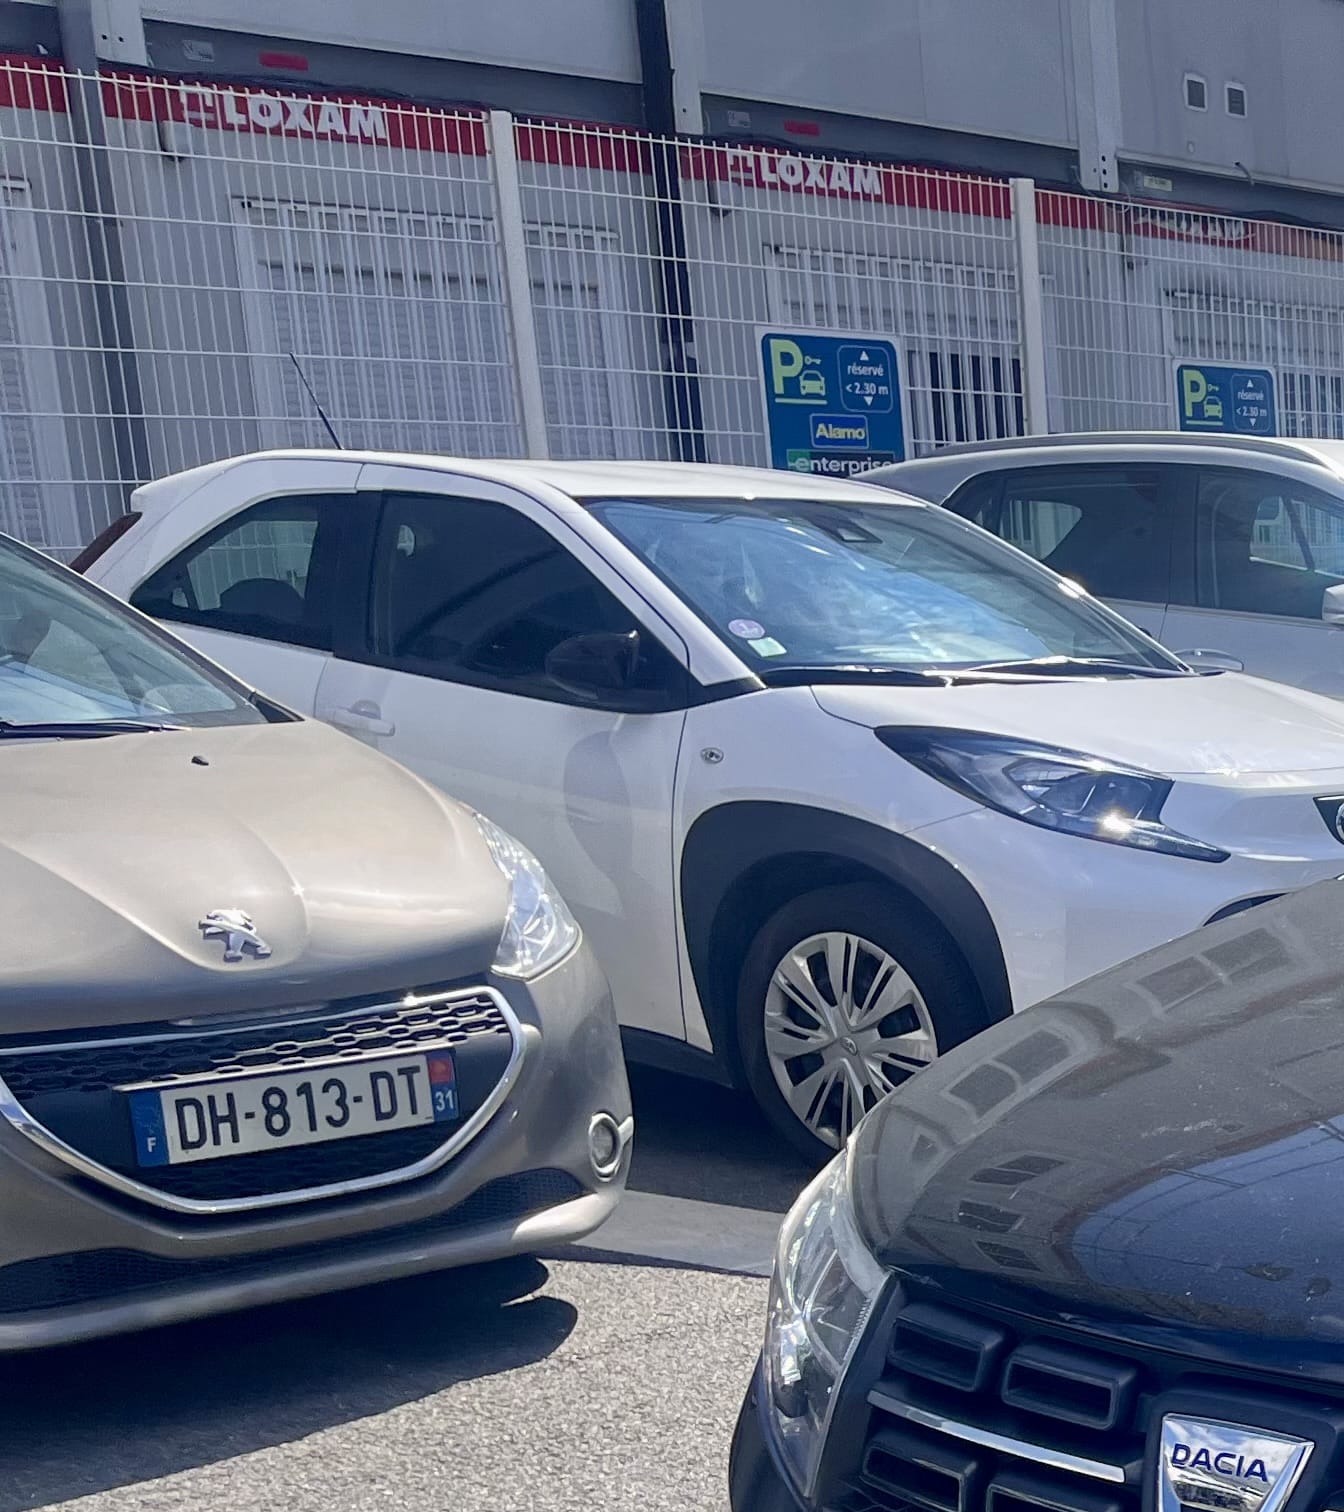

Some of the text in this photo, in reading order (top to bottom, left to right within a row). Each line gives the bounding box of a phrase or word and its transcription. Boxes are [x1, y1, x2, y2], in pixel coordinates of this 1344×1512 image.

[223, 86, 388, 139] LOXAM
[761, 151, 882, 195] LOXAM
[769, 339, 803, 395] P
[847, 362, 884, 377] réservé
[854, 382, 877, 395] 2.30
[878, 385, 889, 395] m
[1183, 369, 1207, 417] P
[815, 423, 866, 440] Alamo
[174, 1065, 421, 1151] DH-813-DT
[435, 1089, 454, 1112] 31
[147, 1137, 156, 1153] F
[1171, 1443, 1268, 1483] DACIA
